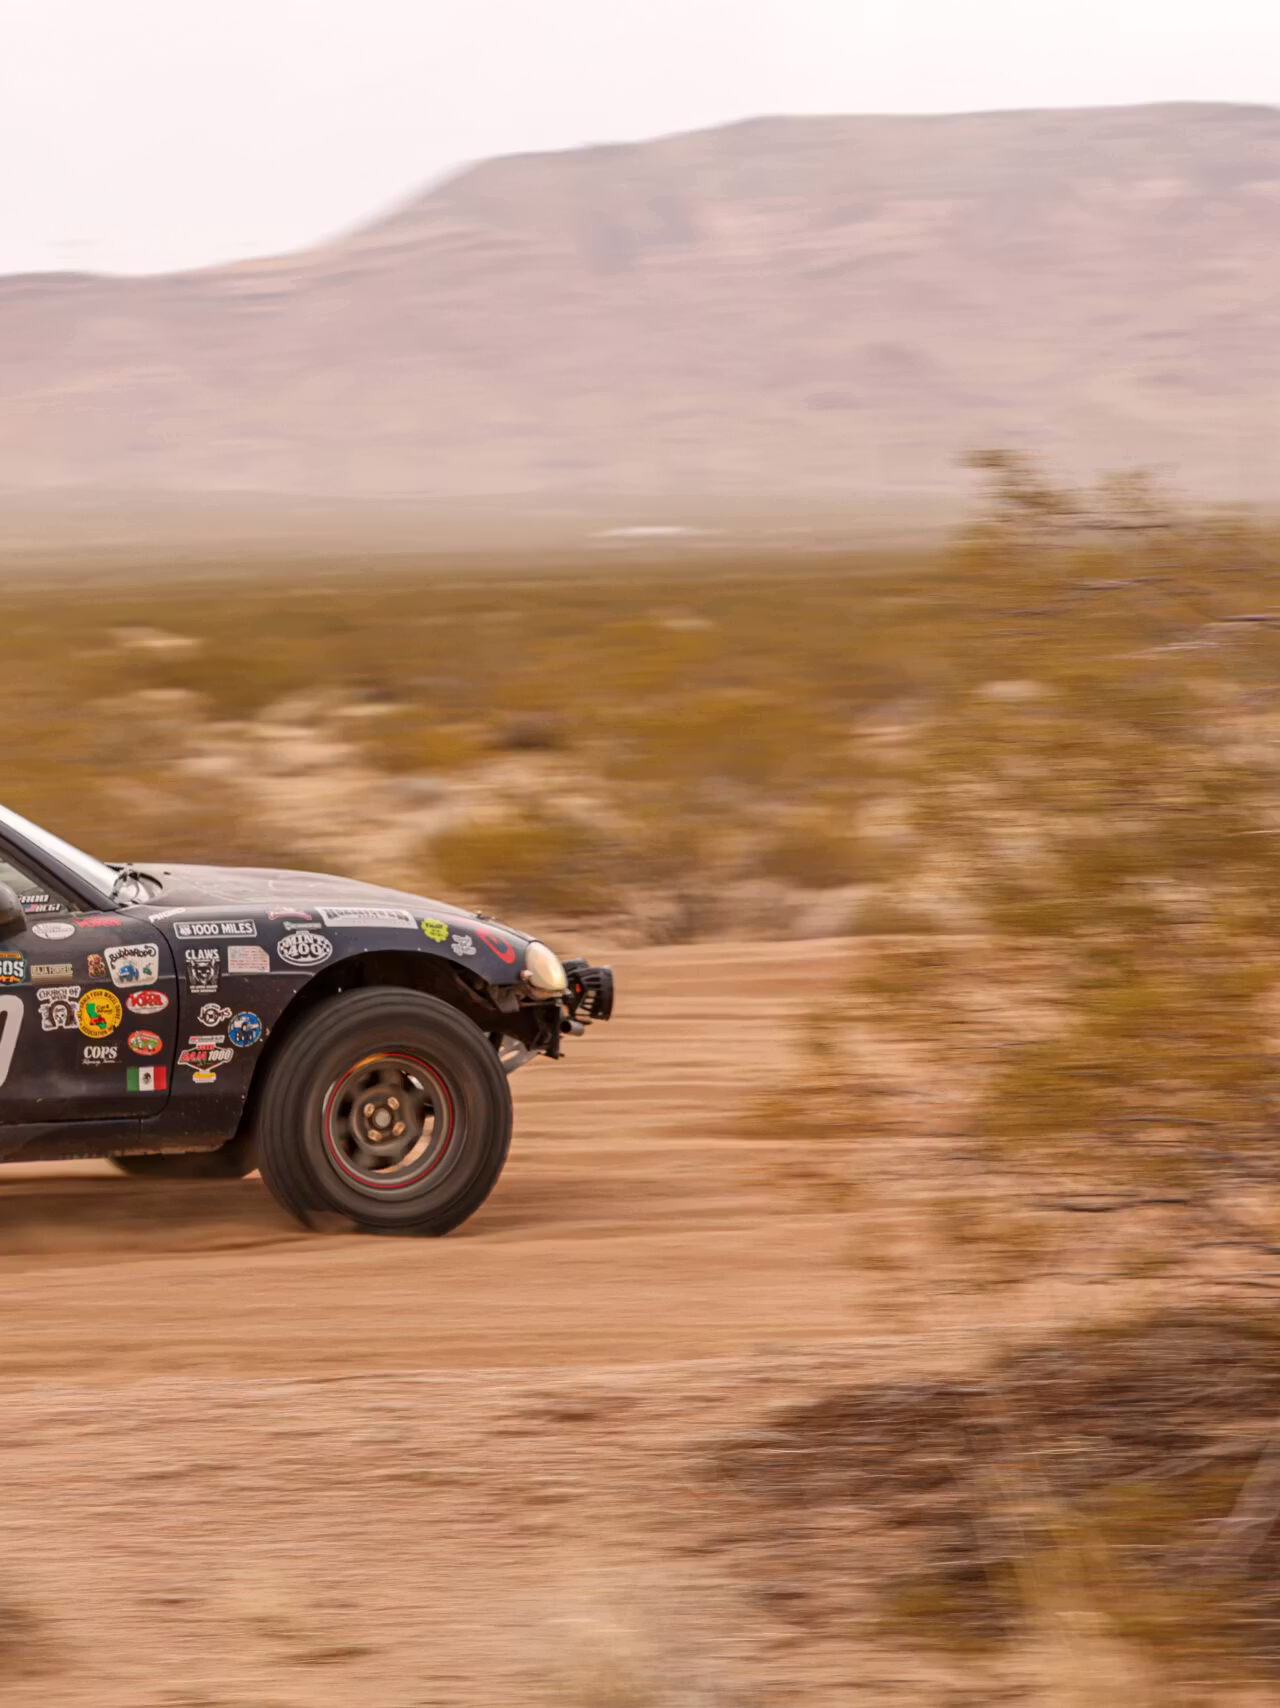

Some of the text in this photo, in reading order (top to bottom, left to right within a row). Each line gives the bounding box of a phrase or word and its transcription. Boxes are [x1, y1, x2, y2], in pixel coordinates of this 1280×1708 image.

[192, 923, 253, 935] 1000 MILES
[282, 933, 323, 946] MINT
[185, 949, 220, 960] CLAWS
[287, 943, 323, 958] 400
[83, 1046, 118, 1059] COPS
[208, 1049, 233, 1061] 1000
